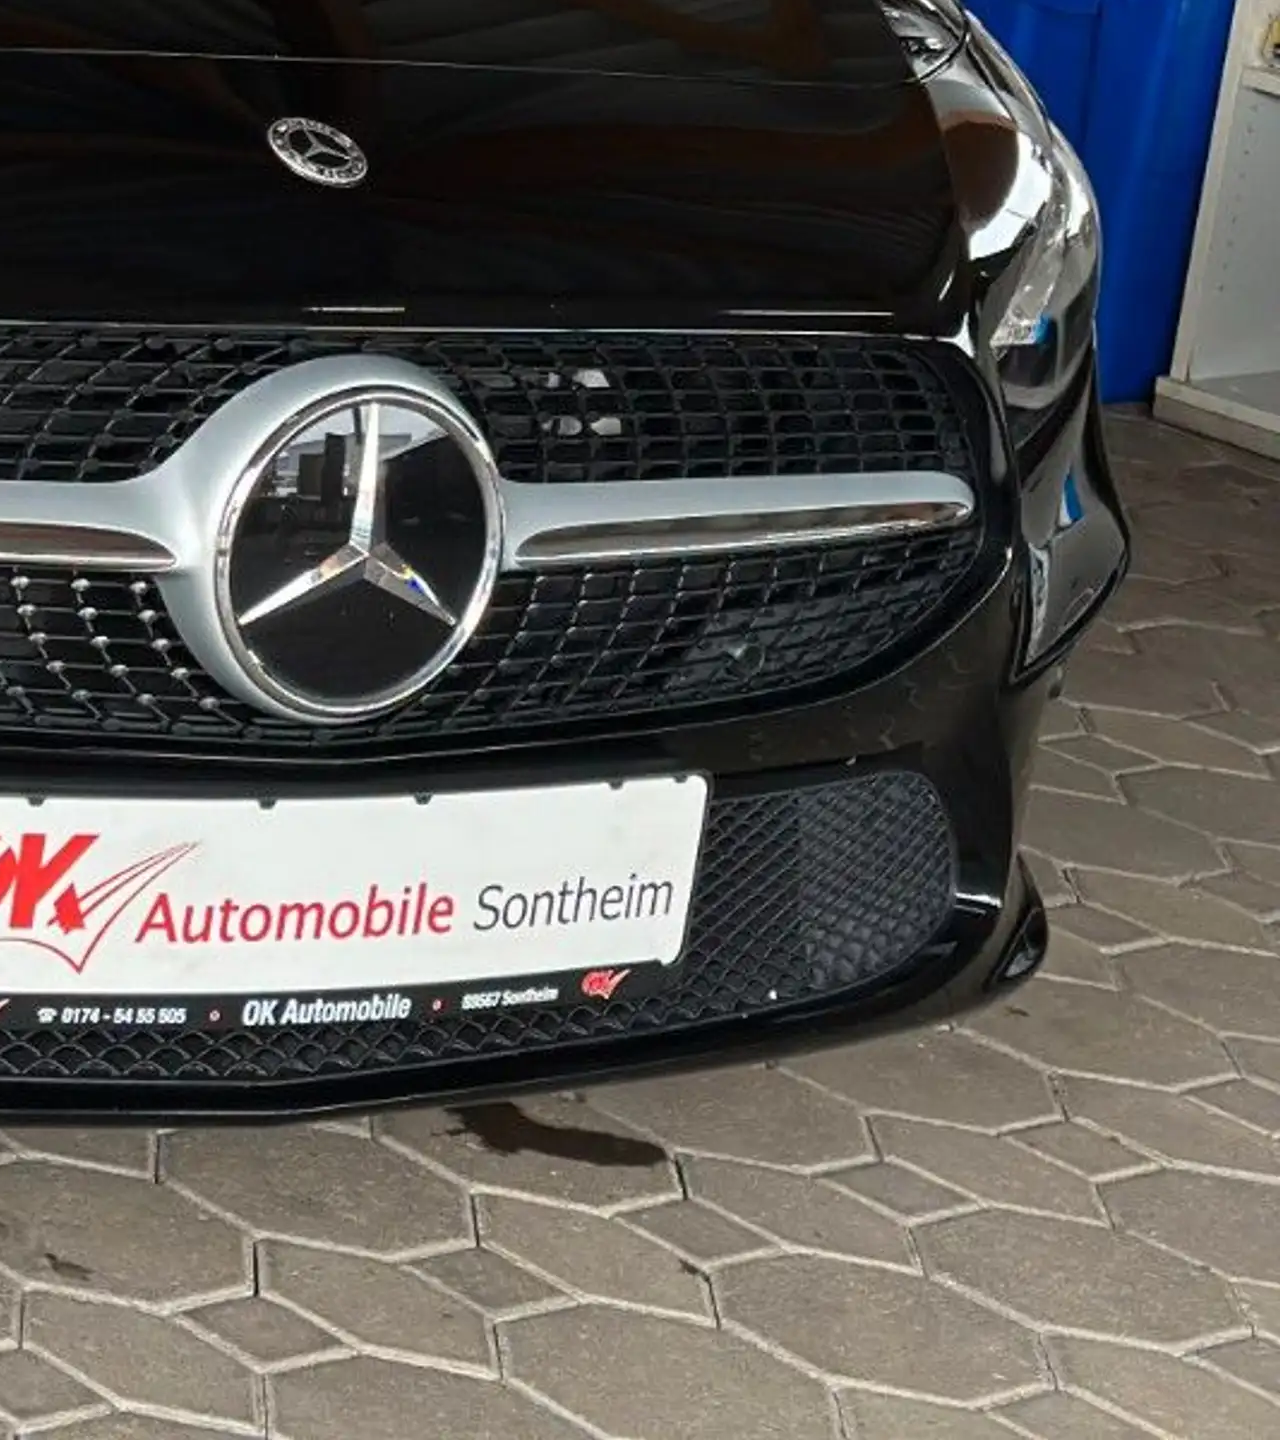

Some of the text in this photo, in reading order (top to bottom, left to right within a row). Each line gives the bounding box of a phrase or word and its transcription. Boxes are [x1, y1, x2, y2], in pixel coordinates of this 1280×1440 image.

[134, 873, 675, 944] Automobile Sontheim
[61, 1007, 100, 1024] 0174
[243, 1000, 278, 1026] OK
[280, 993, 412, 1025] Automobile
